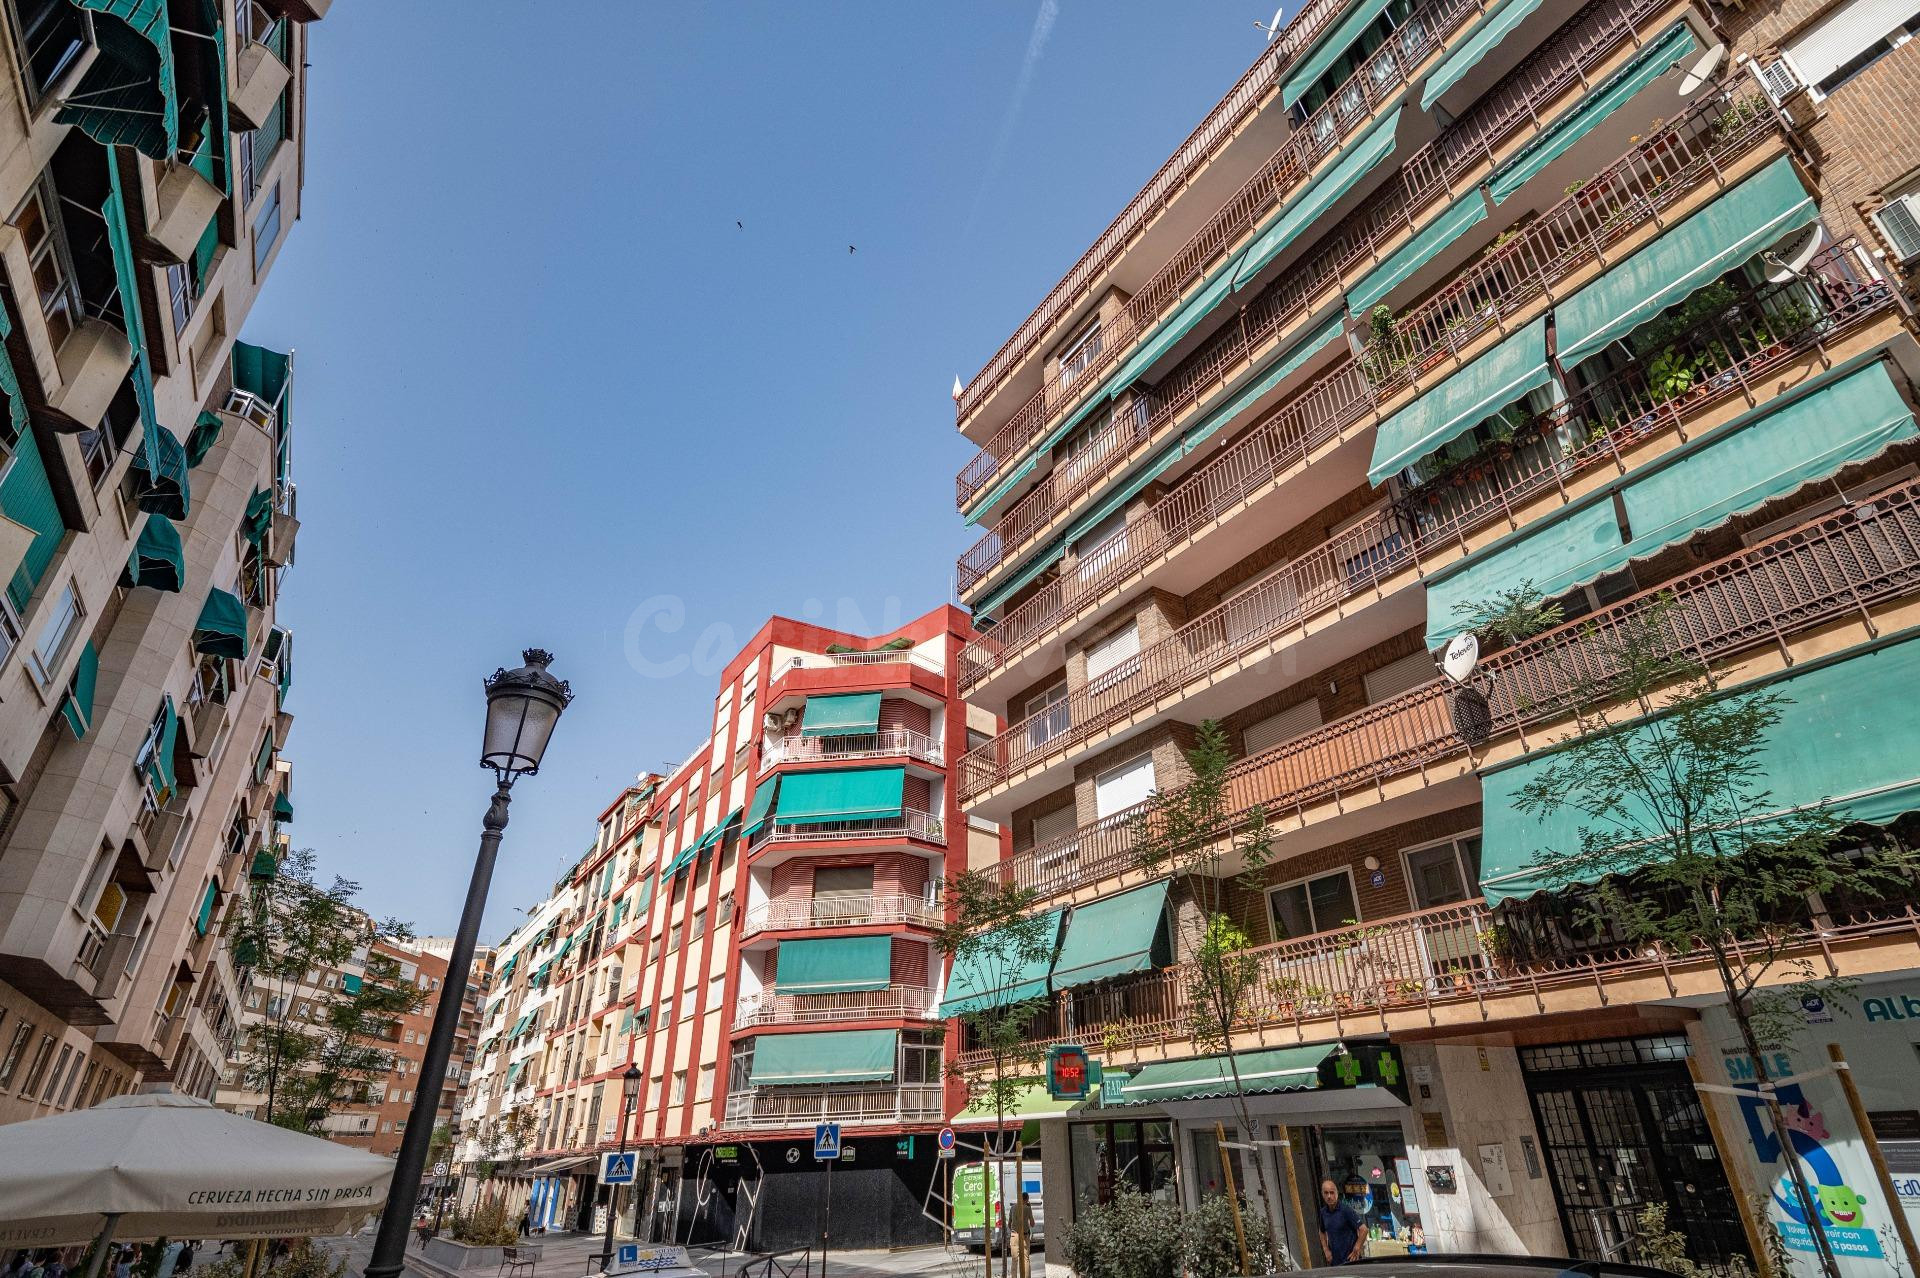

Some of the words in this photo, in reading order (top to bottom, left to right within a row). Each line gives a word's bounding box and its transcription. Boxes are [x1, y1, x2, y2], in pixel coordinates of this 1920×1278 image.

[1774, 229, 1812, 260] elevés
[1062, 1067, 1079, 1078] 10:52
[1725, 1052, 1794, 1081] SMLE
[963, 1181, 983, 1192] Cero
[188, 1191, 251, 1204] CERVEZA
[255, 1189, 302, 1203] HECHA
[306, 1188, 331, 1201] SIN
[334, 1186, 372, 1200] PRISA
[1842, 1231, 1861, 1240] con
[1840, 1242, 1869, 1252] pasos
[623, 1248, 633, 1261] L
